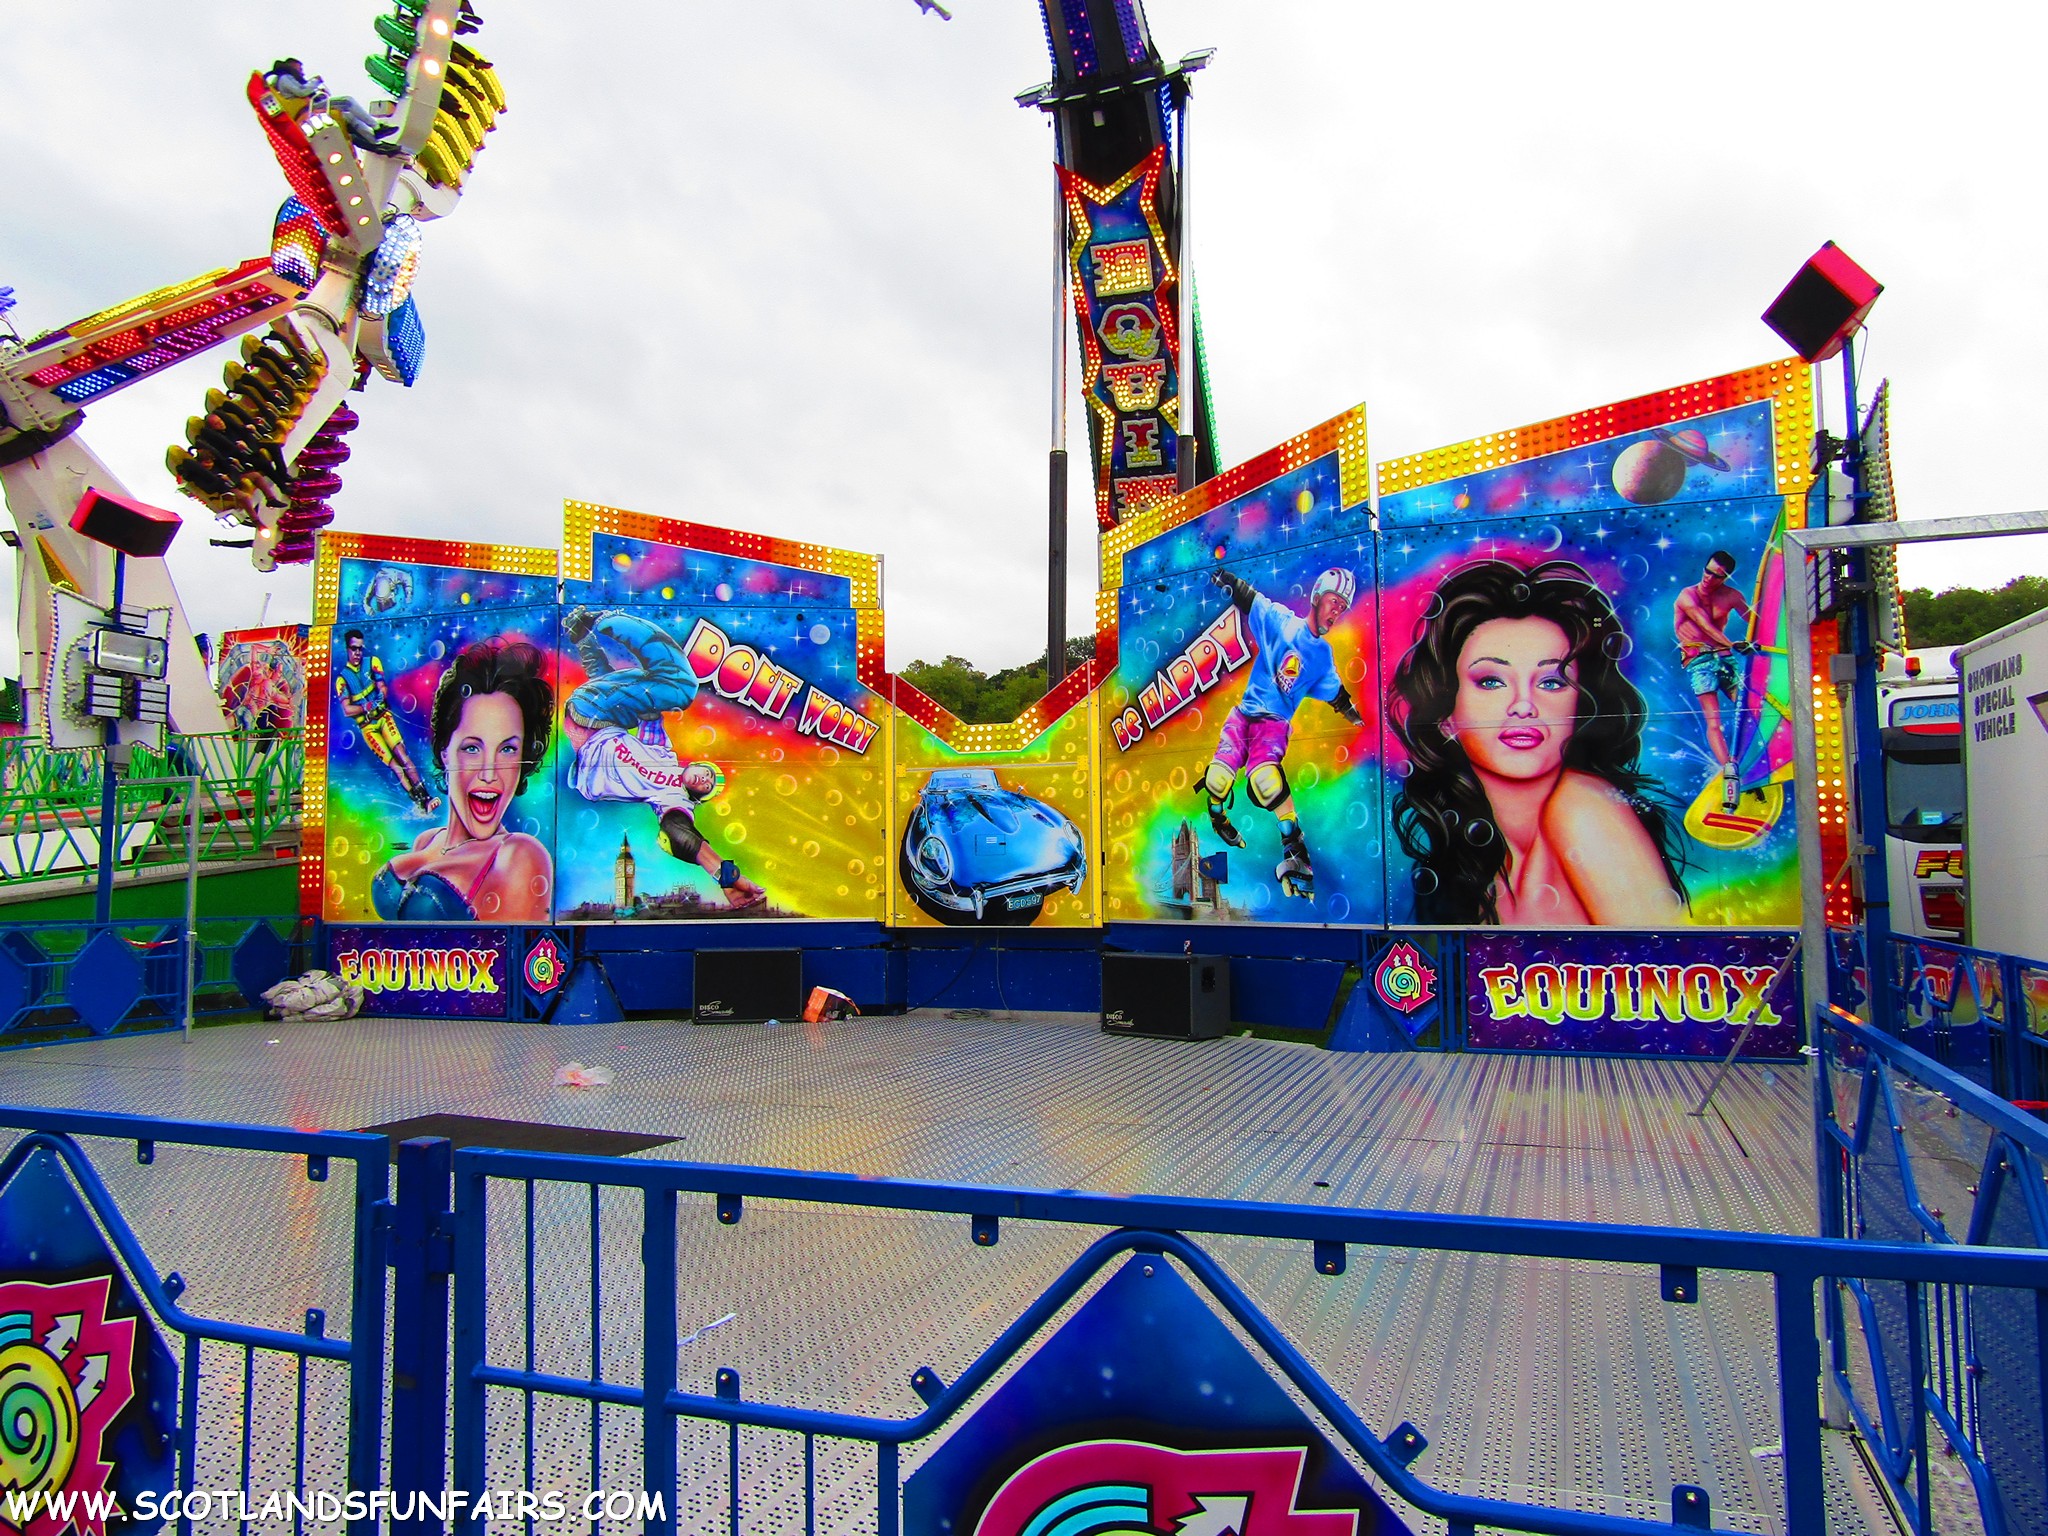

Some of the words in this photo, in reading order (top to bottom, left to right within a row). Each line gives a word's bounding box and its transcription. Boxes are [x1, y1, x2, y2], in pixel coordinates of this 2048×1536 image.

[1138, 603, 1252, 729] HAPPY
[1967, 653, 2022, 693] SHOWMANS
[798, 685, 881, 755] WORRY
[1974, 685, 2015, 717] SPECIAL
[1974, 712, 2016, 742] VEHICLE
[337, 948, 499, 994] EQUINOX
[1478, 963, 1782, 1026] EQUINOX
